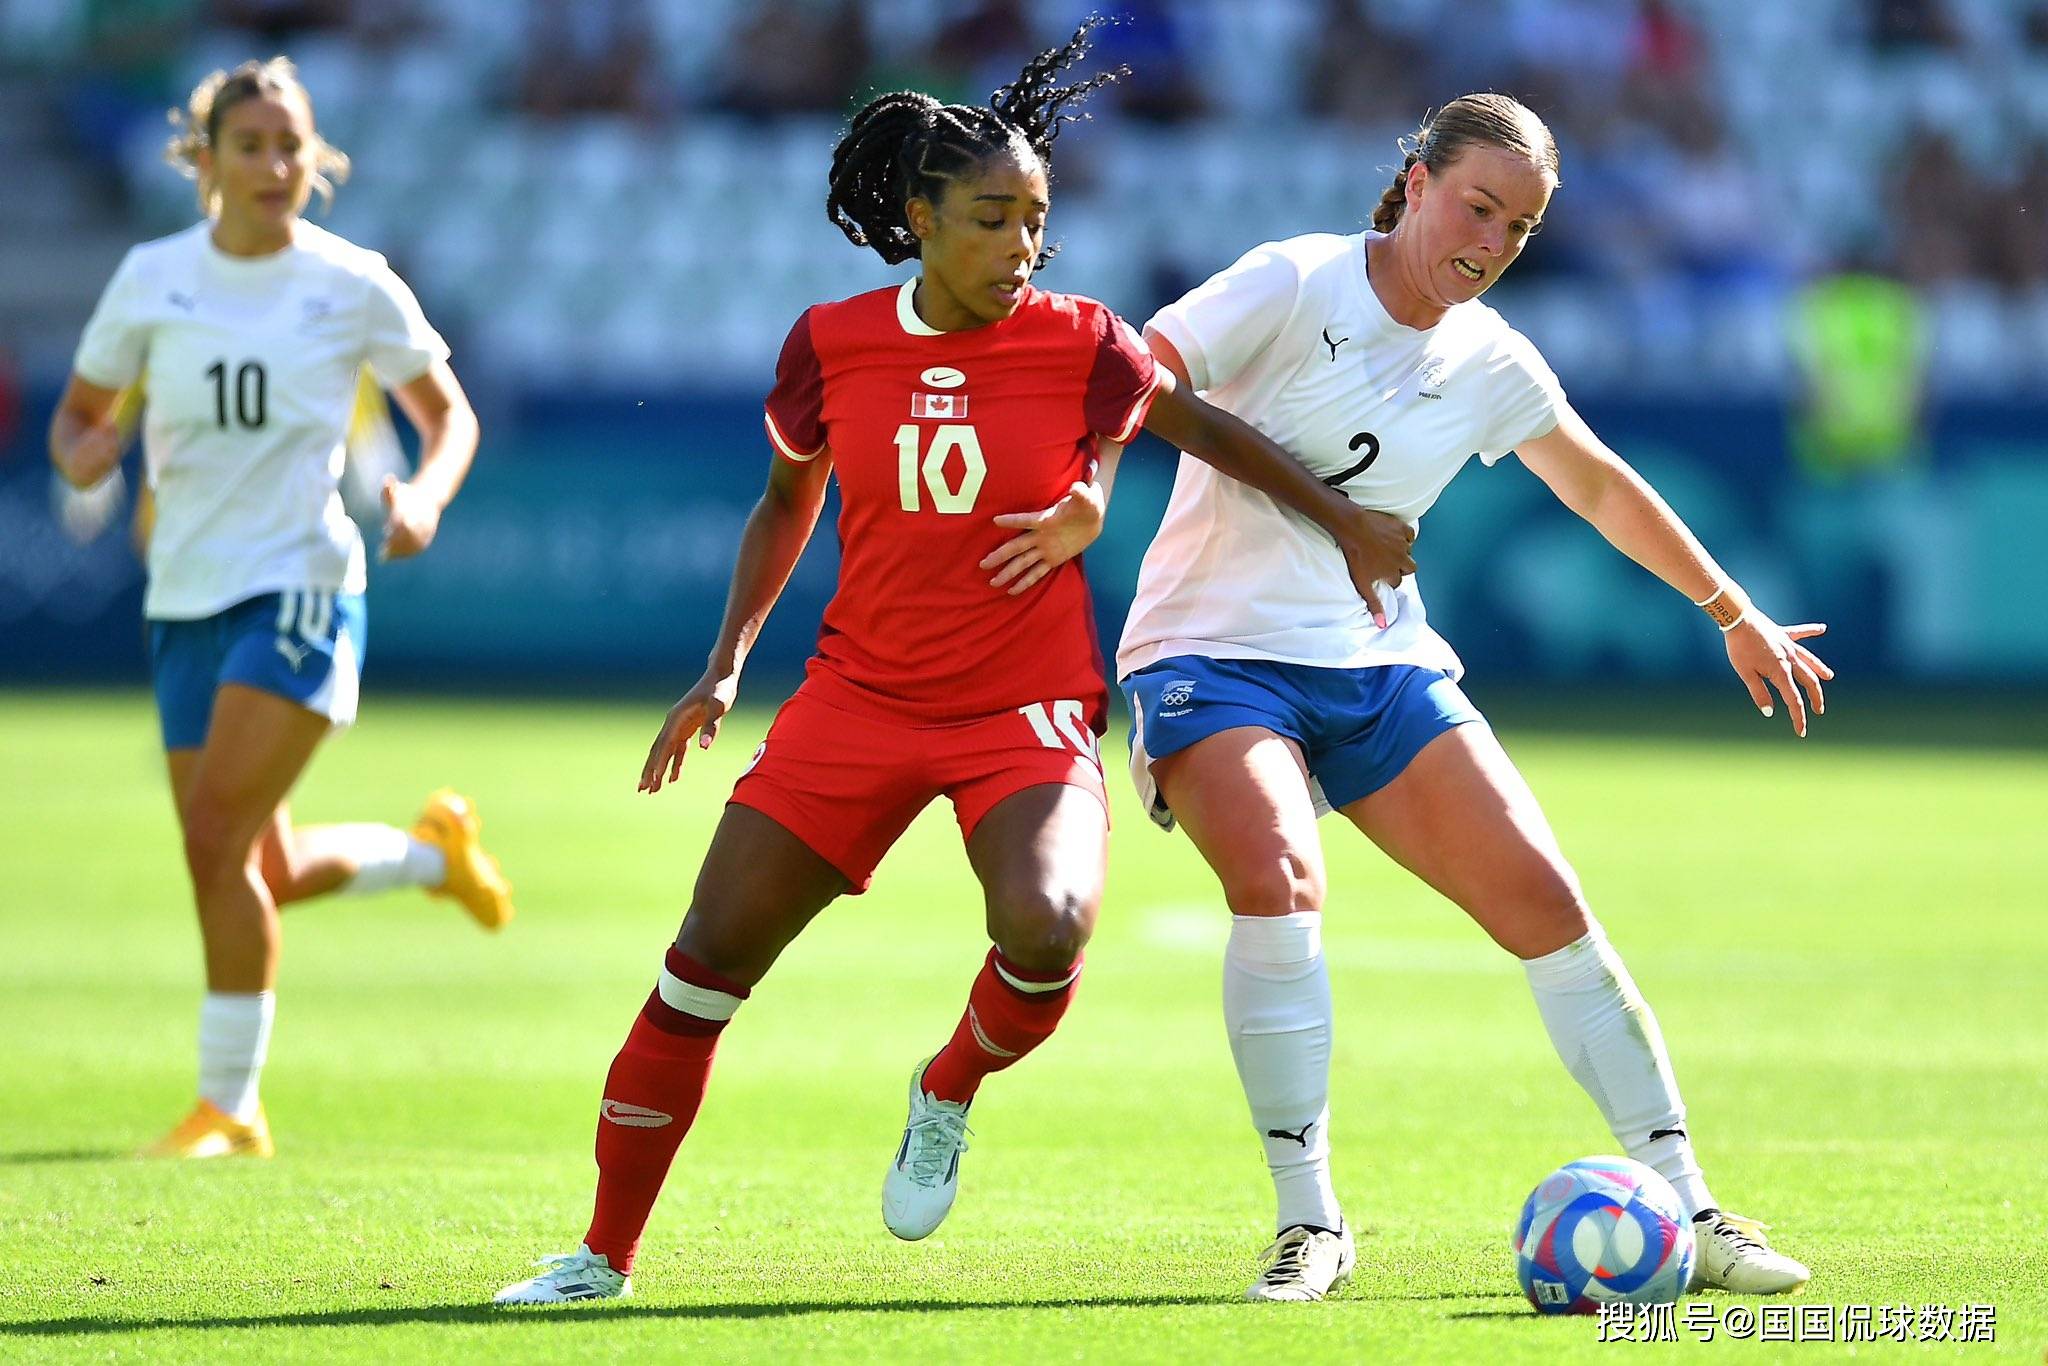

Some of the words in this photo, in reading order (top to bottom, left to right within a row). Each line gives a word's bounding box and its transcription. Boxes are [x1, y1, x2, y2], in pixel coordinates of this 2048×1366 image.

[204, 359, 266, 430] 10
[893, 425, 987, 514] 10
[1322, 431, 1380, 499] 2
[1018, 700, 1099, 766] 10
